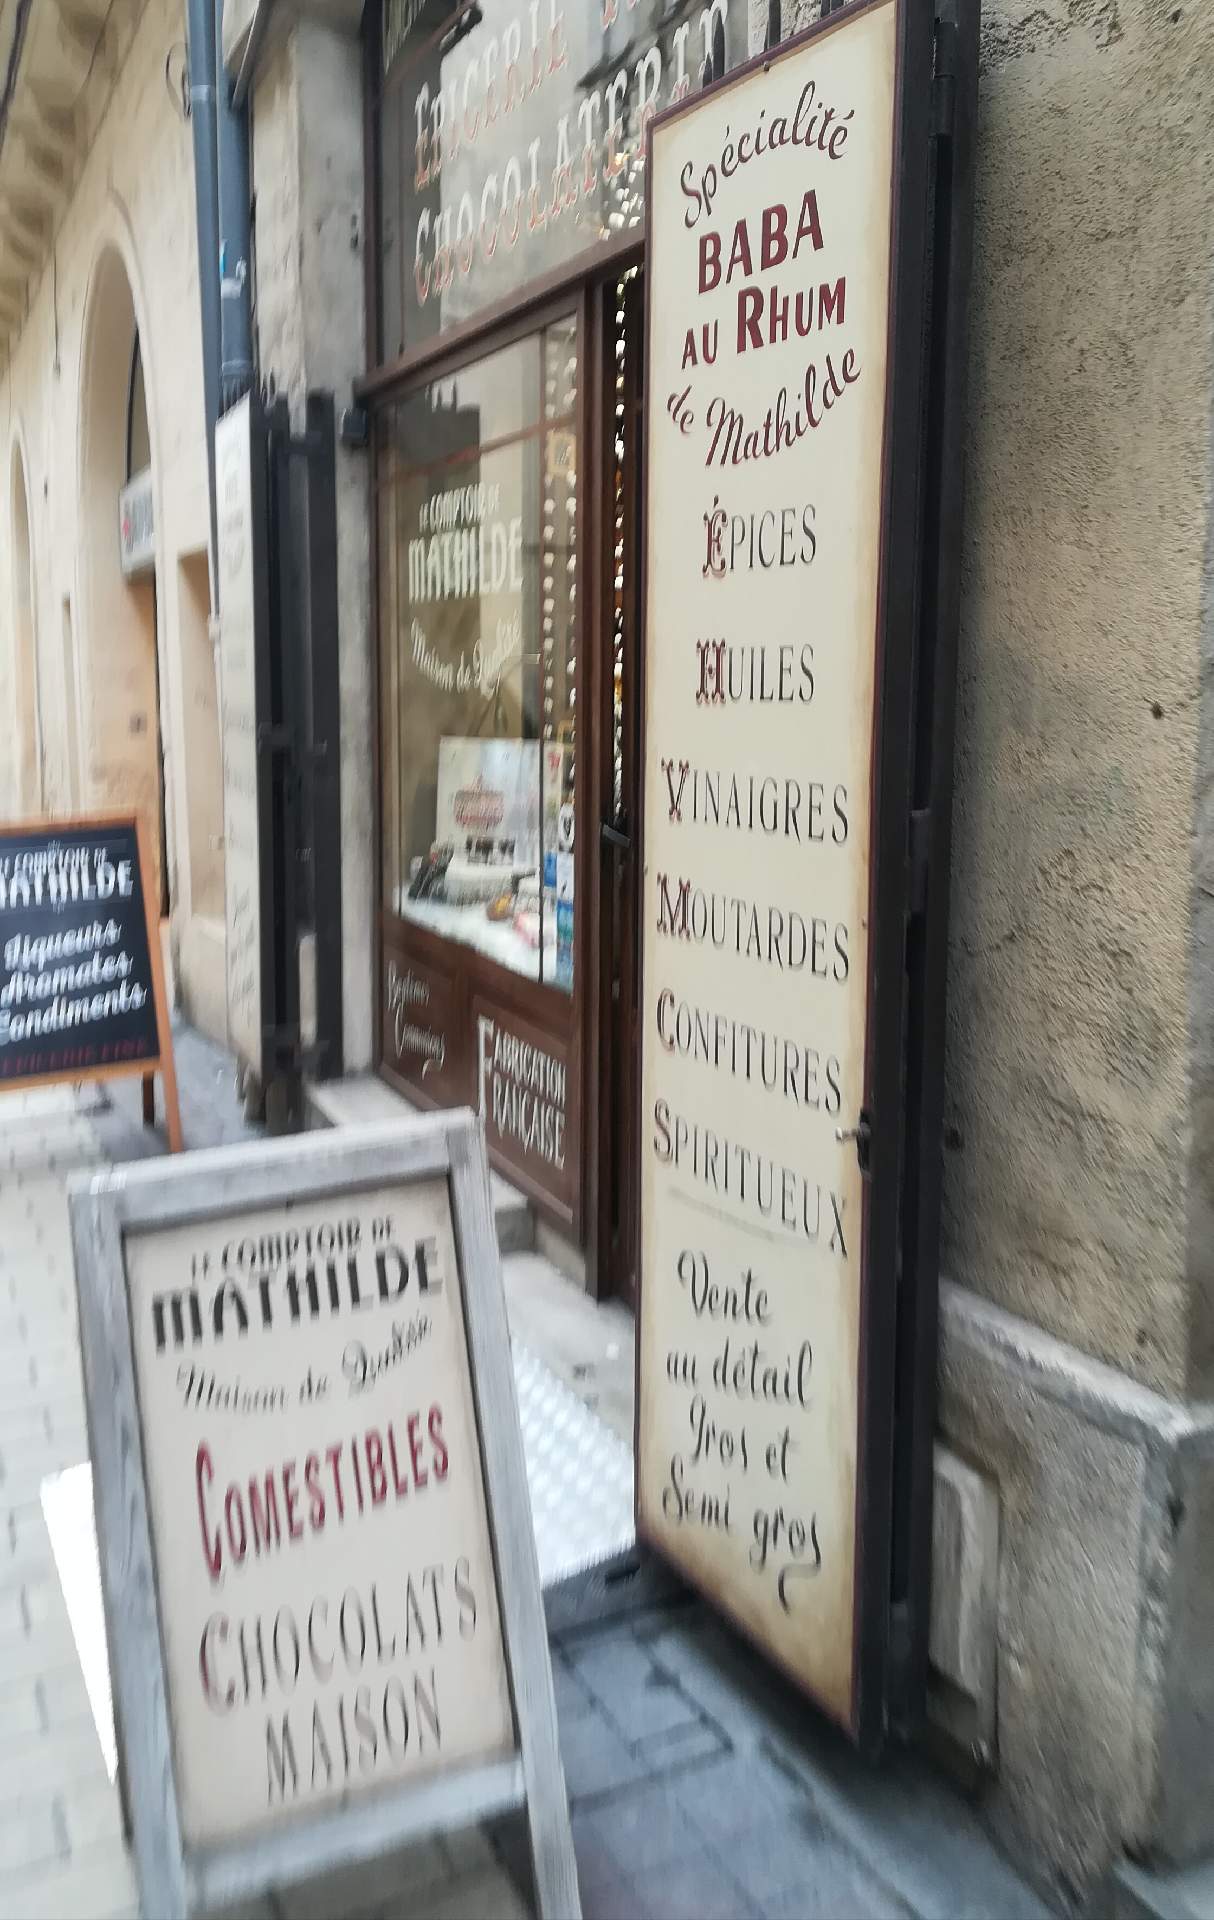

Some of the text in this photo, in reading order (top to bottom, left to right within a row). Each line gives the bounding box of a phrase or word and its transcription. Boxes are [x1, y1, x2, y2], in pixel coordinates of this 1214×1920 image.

[680, 80, 855, 229] Spécialité
[698, 189, 824, 295] BABA
[681, 276, 846, 370] AU RHUM
[666, 347, 861, 467] de Mathilde
[408, 516, 524, 604] MATHILDE
[702, 494, 817, 578] ÉPICES
[695, 638, 815, 705] HUILES
[660, 757, 849, 847] VINAIGRES
[656, 871, 850, 985] MOUTARDES
[656, 987, 842, 1118] CONFITURES
[653, 1098, 848, 1261] SPIRITUEUX
[151, 1236, 443, 1358] MATHILDE
[221, 1217, 362, 1271] COMPTOIR
[677, 1249, 770, 1326] Vente
[666, 1335, 812, 1410] au détail
[195, 1401, 449, 1581] COMESTIBLES
[765, 1425, 797, 1484] et
[662, 1452, 821, 1616] Semi gros
[200, 1555, 477, 1717] CHOCOLATS
[266, 1665, 441, 1806] MAISON
